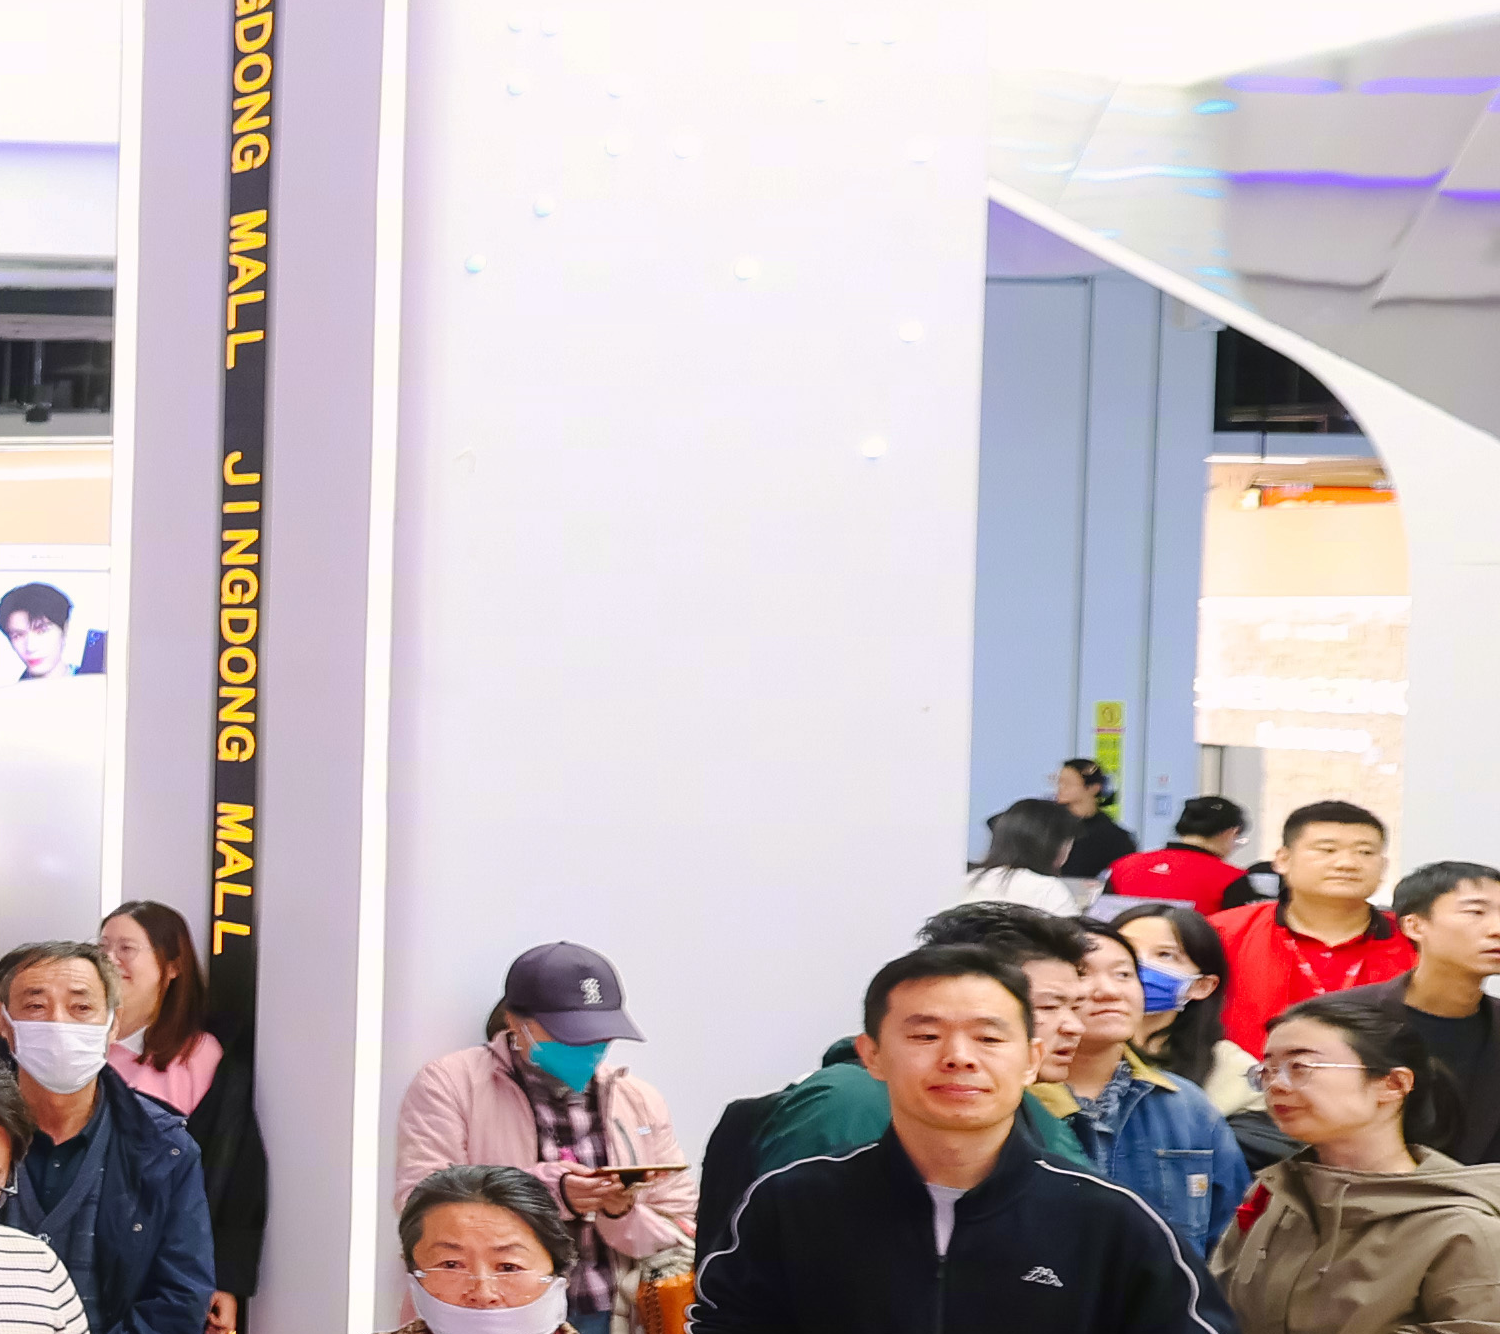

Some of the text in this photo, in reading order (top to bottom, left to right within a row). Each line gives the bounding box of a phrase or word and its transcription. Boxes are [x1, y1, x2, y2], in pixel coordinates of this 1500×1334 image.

[226, 208, 267, 369] MALL
[214, 451, 260, 957] JINGDONG MALL
